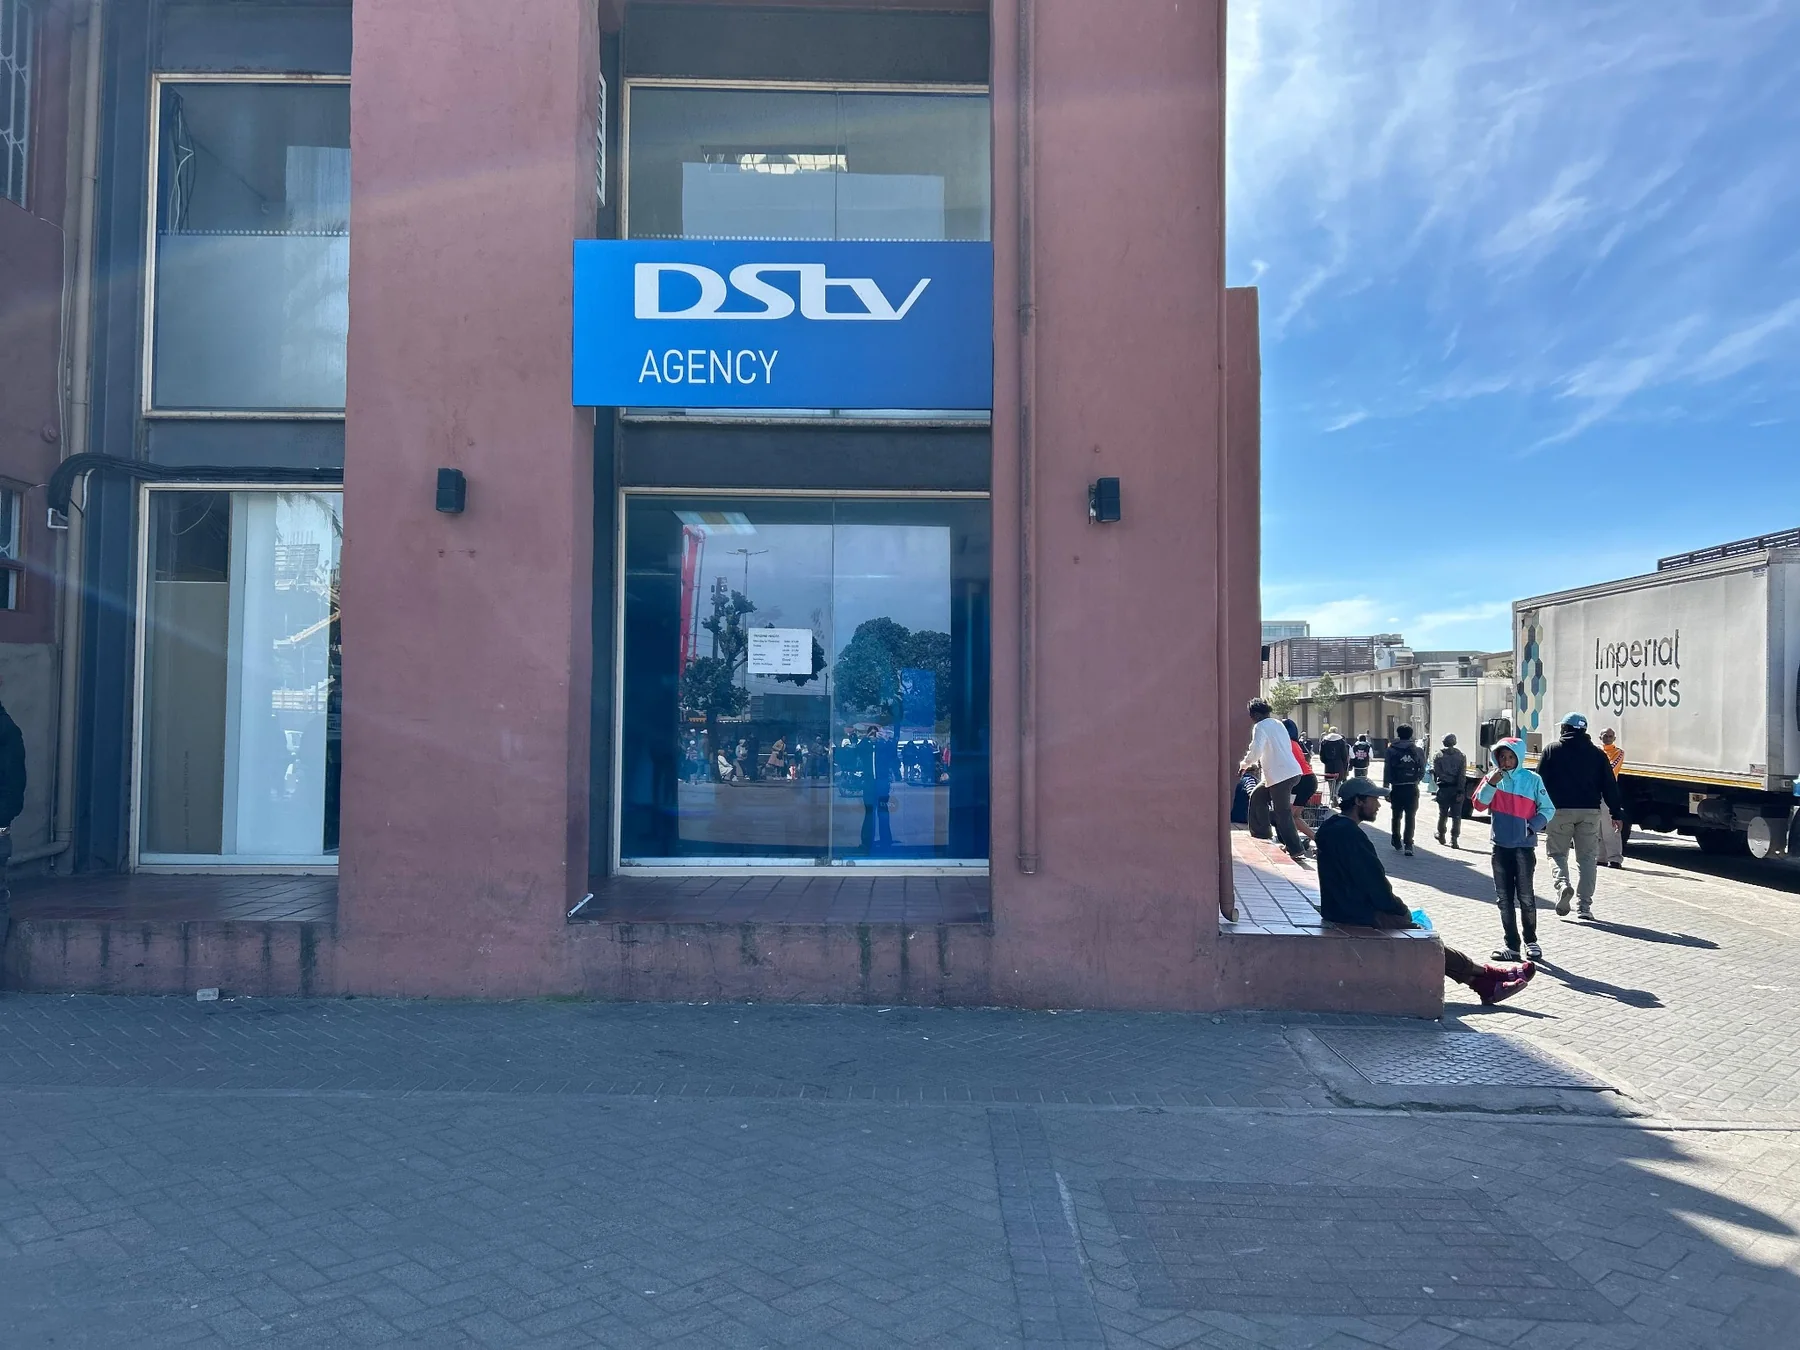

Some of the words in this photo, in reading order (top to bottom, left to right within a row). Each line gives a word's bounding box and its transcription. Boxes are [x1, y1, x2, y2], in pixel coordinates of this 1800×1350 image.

[634, 262, 932, 321] DStv
[638, 349, 779, 384] AGENCY
[1595, 628, 1681, 677] Imperial
[1594, 672, 1681, 717] logistics
